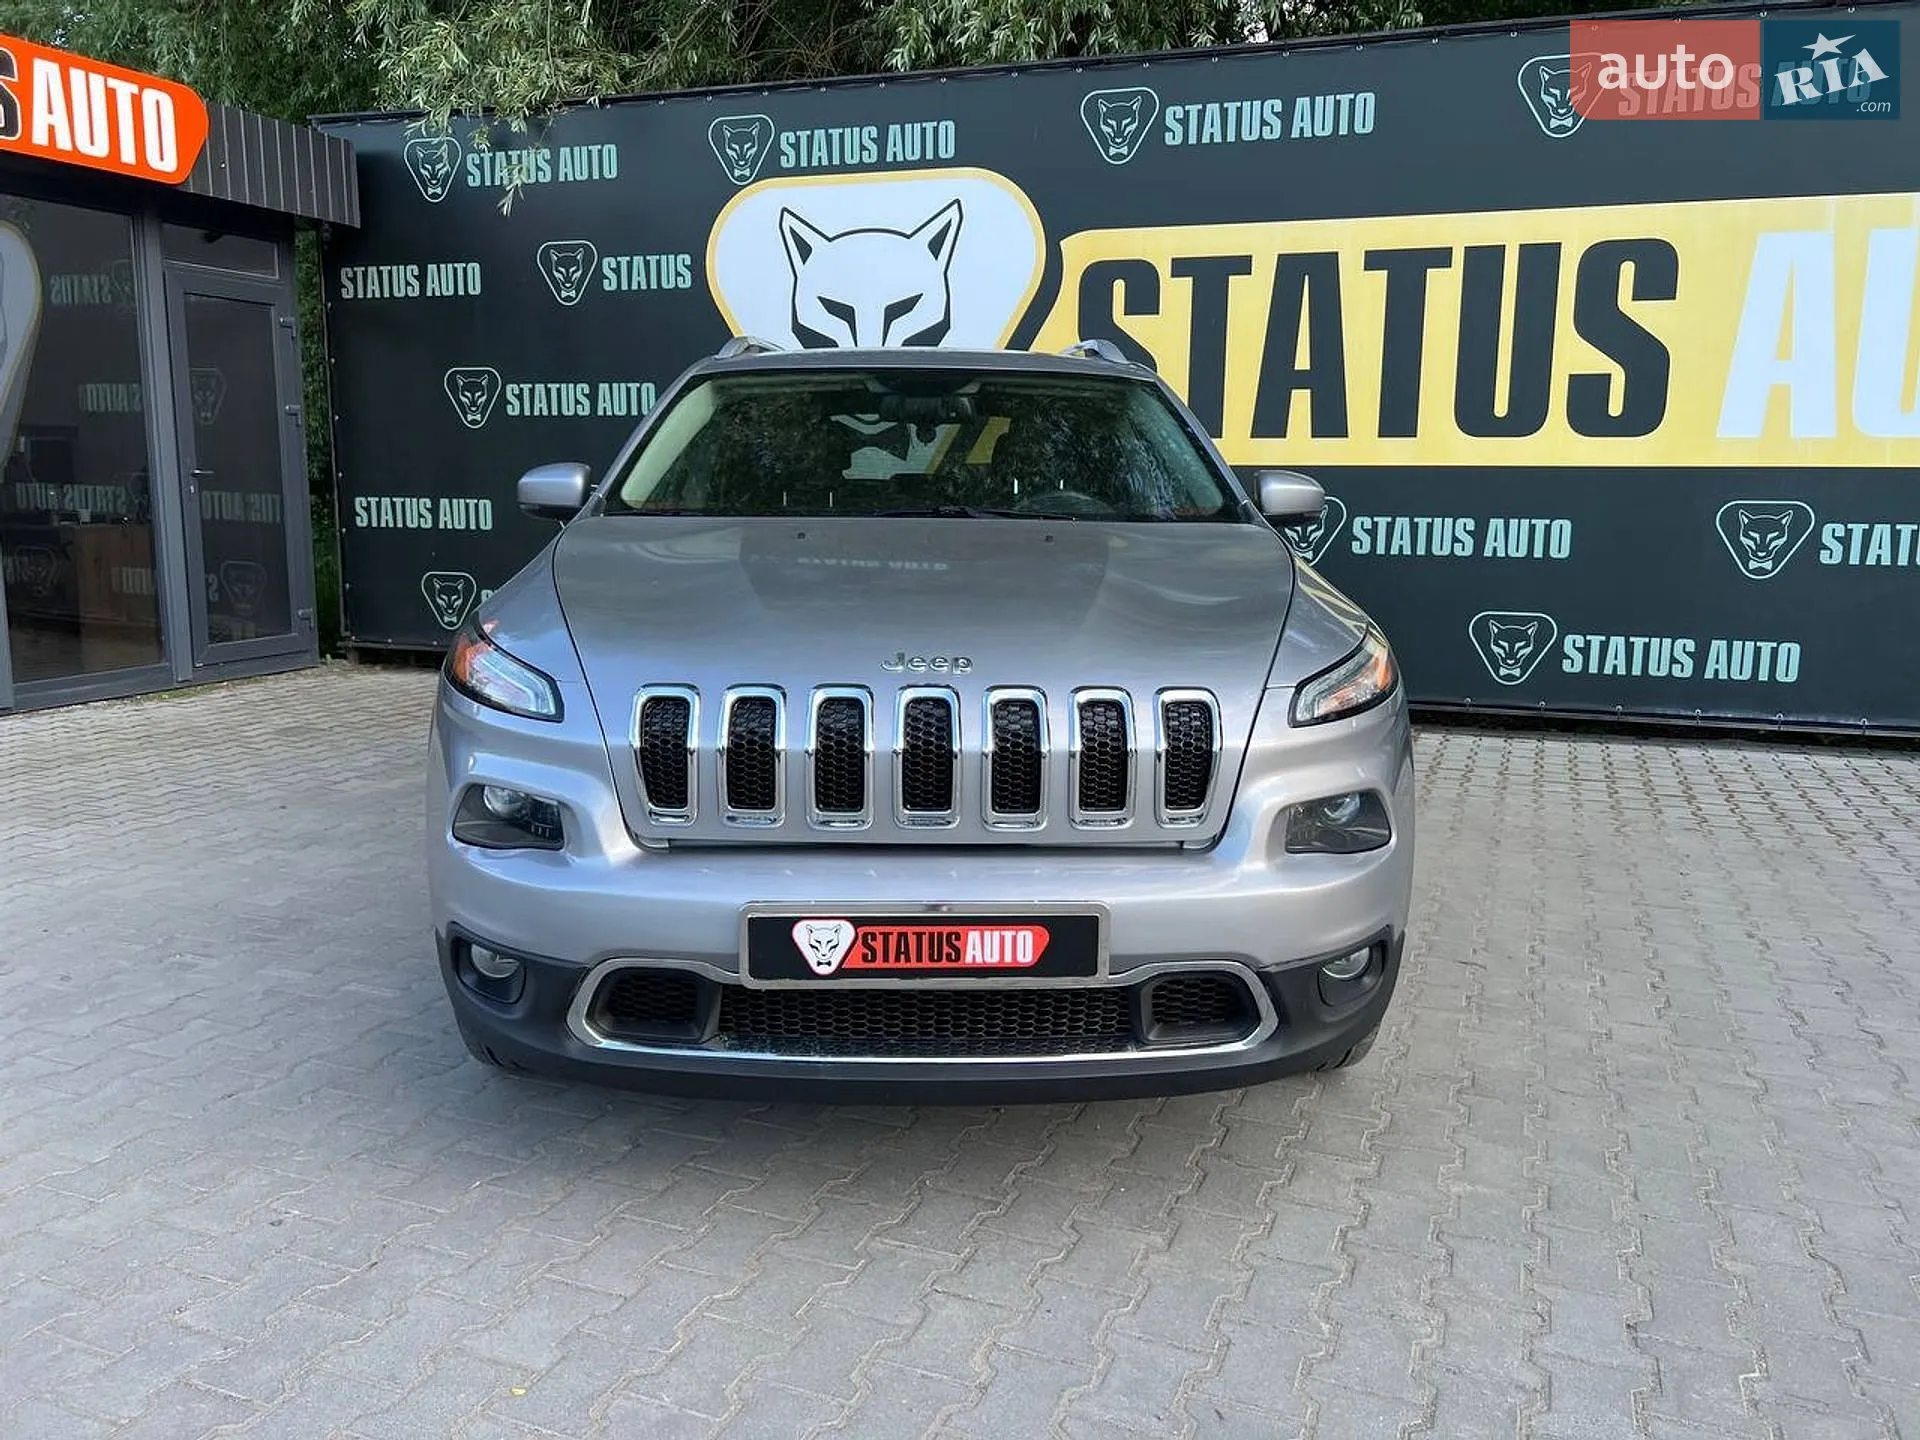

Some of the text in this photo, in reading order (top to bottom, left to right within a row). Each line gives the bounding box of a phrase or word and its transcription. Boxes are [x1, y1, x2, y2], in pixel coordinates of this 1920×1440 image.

[32, 57, 178, 173] AUTO
[1164, 92, 1375, 146] STATUS AUTO
[466, 143, 618, 188] STATUS AUTO
[780, 120, 955, 168] STATUS AUTO
[340, 262, 481, 299] STATUS AUTO
[602, 254, 692, 291] STATUS
[1078, 239, 1679, 439] STATUS
[505, 382, 656, 416] STATUS AUTO
[354, 496, 493, 530] STATUS AUTO
[1351, 516, 1572, 559] STATUS AUTO
[1819, 523, 1920, 566] STAT
[880, 652, 974, 675] Jeep
[1562, 634, 1801, 683] STATUS AUTO
[861, 930, 1033, 963] STATUS AUTO
